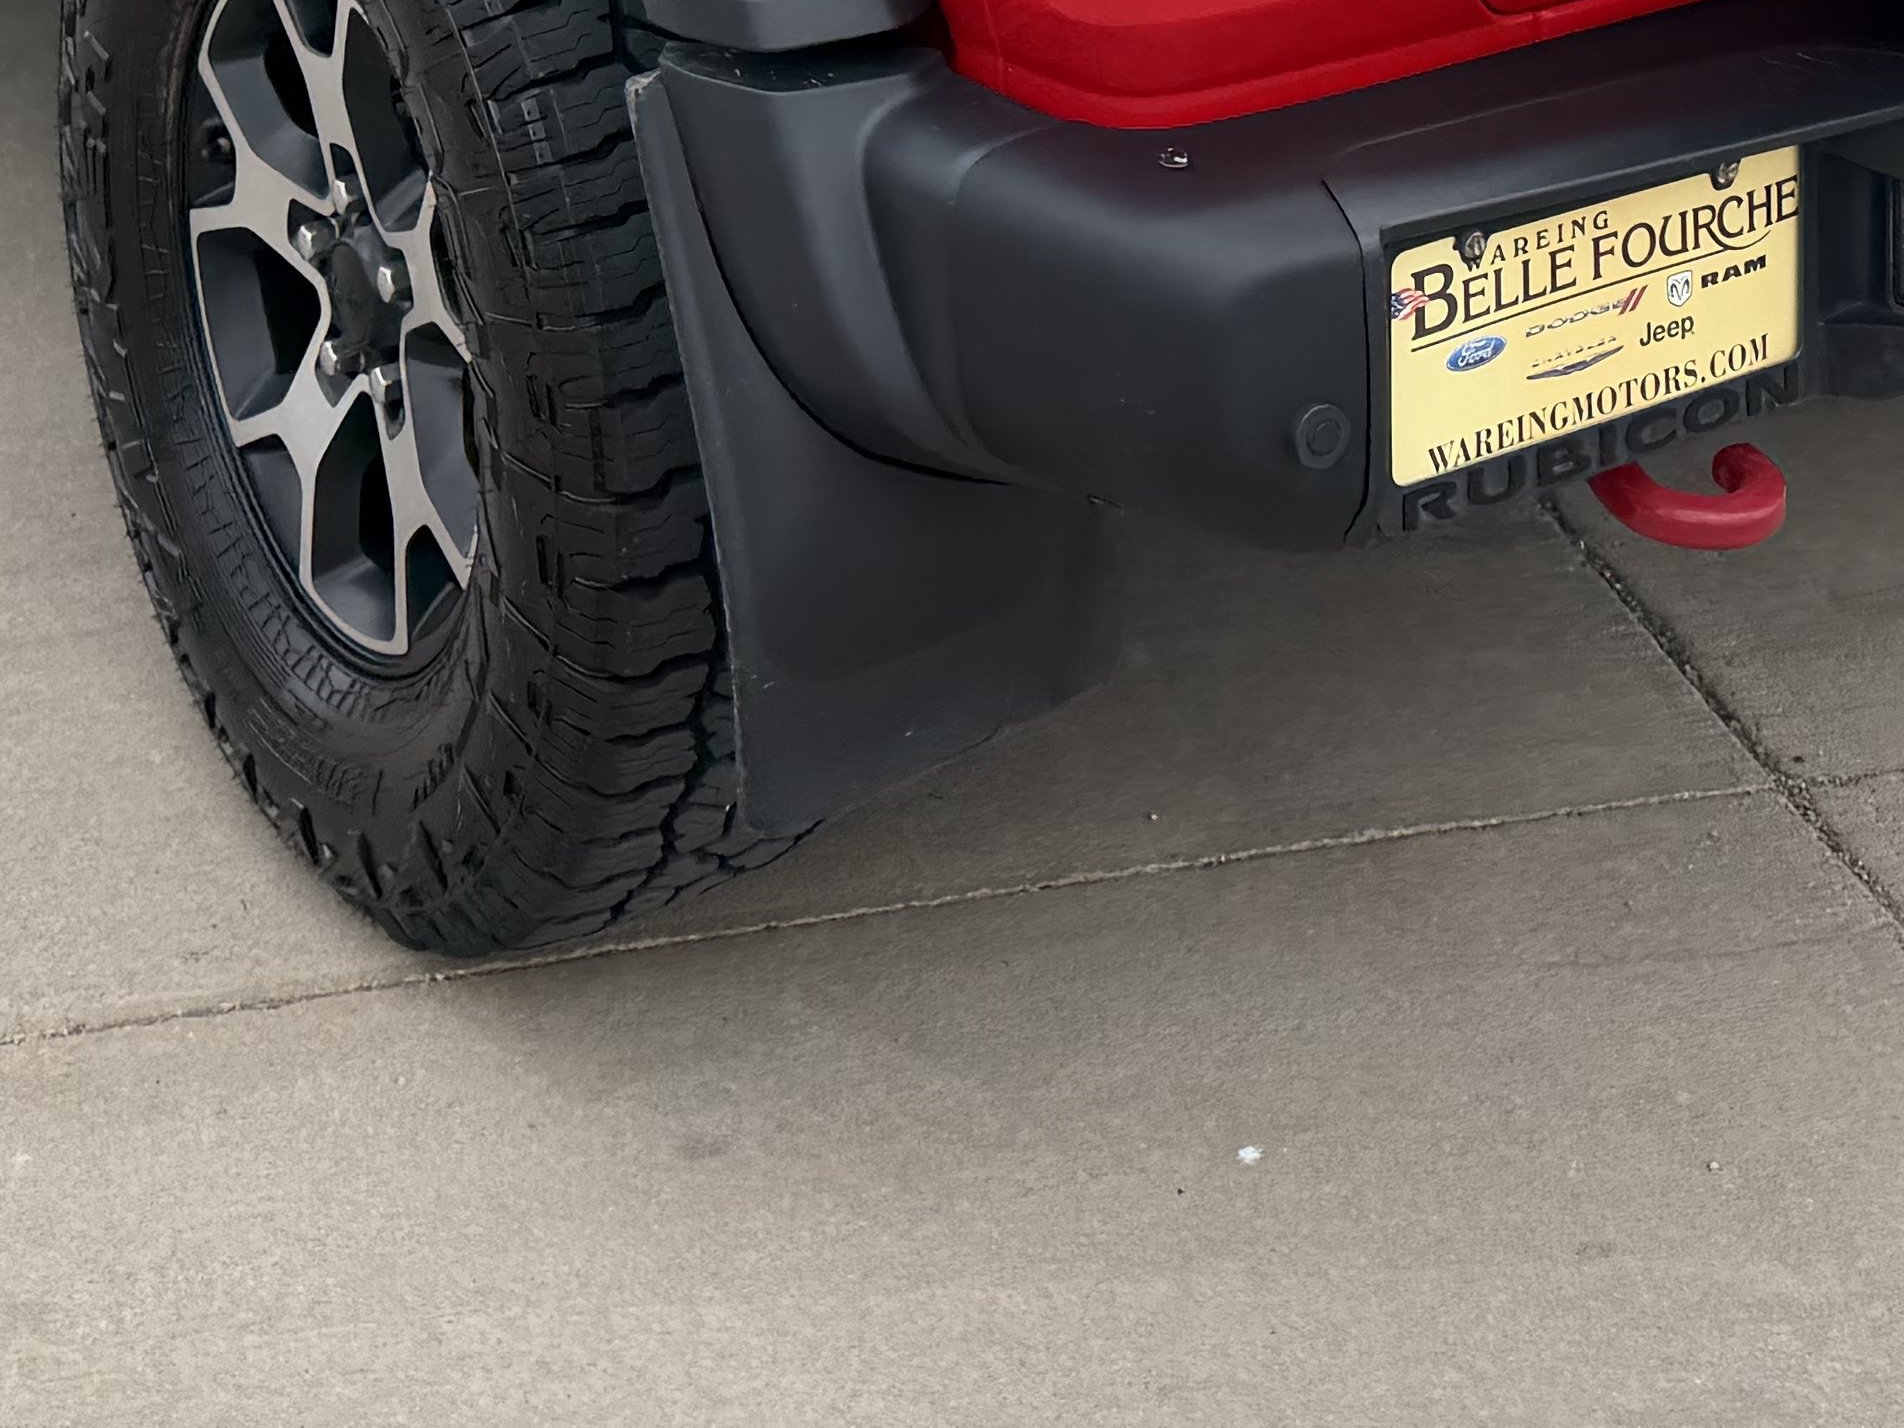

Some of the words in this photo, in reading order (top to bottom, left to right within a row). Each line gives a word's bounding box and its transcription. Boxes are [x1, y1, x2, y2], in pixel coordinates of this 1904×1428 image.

[1410, 243, 1578, 342] BELLE
[1591, 174, 1800, 282] FOURCHE
[1700, 254, 1767, 289] RAM
[1525, 298, 1629, 339] DODGE
[1639, 315, 1695, 347] Jeep
[1402, 363, 1800, 532] RUBICON
[1427, 332, 1770, 475] WAREINGMOTORS.COM
